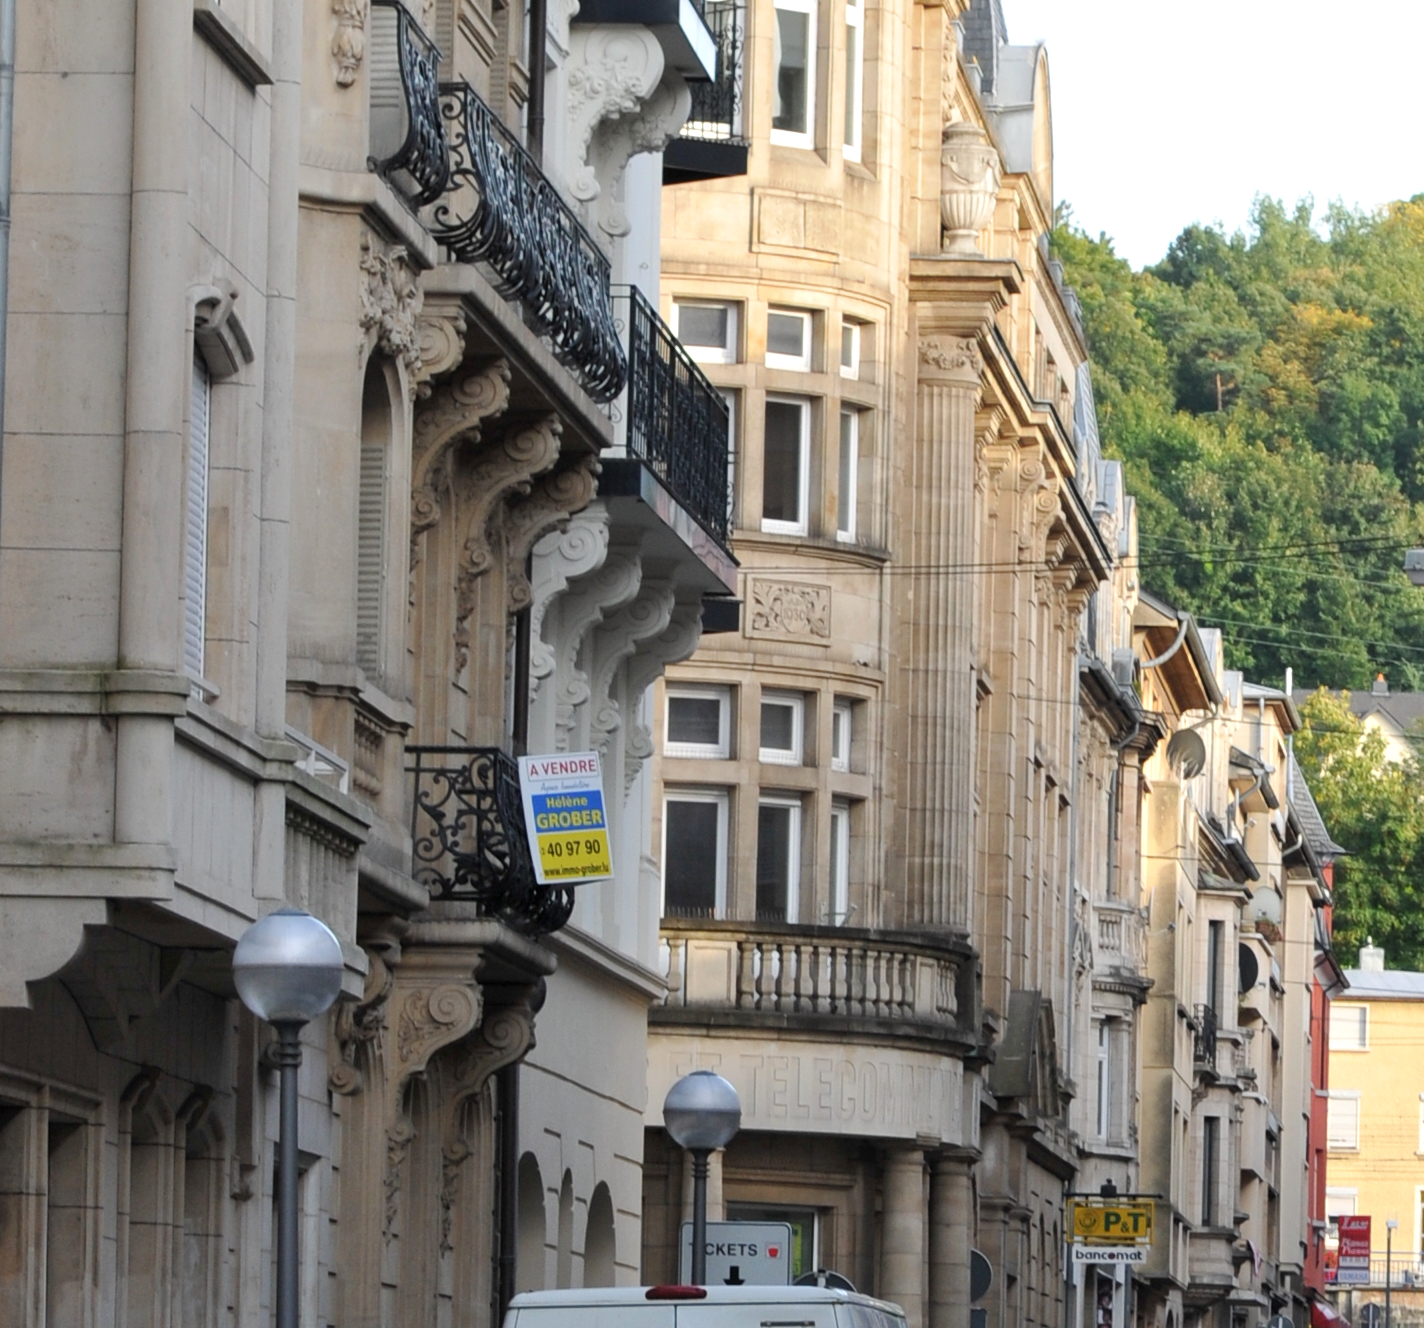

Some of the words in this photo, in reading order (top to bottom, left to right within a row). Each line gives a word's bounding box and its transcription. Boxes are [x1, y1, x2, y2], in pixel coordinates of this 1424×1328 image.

[530, 764, 539, 777] A
[541, 760, 596, 776] VENDRE
[546, 795, 588, 809] Hélène
[536, 809, 603, 829] GROBER
[547, 842, 563, 857] 40
[565, 841, 581, 856] 97
[584, 839, 601, 855] 90
[1104, 1210, 1146, 1233] P&T
[688, 1243, 758, 1257] CKETS
